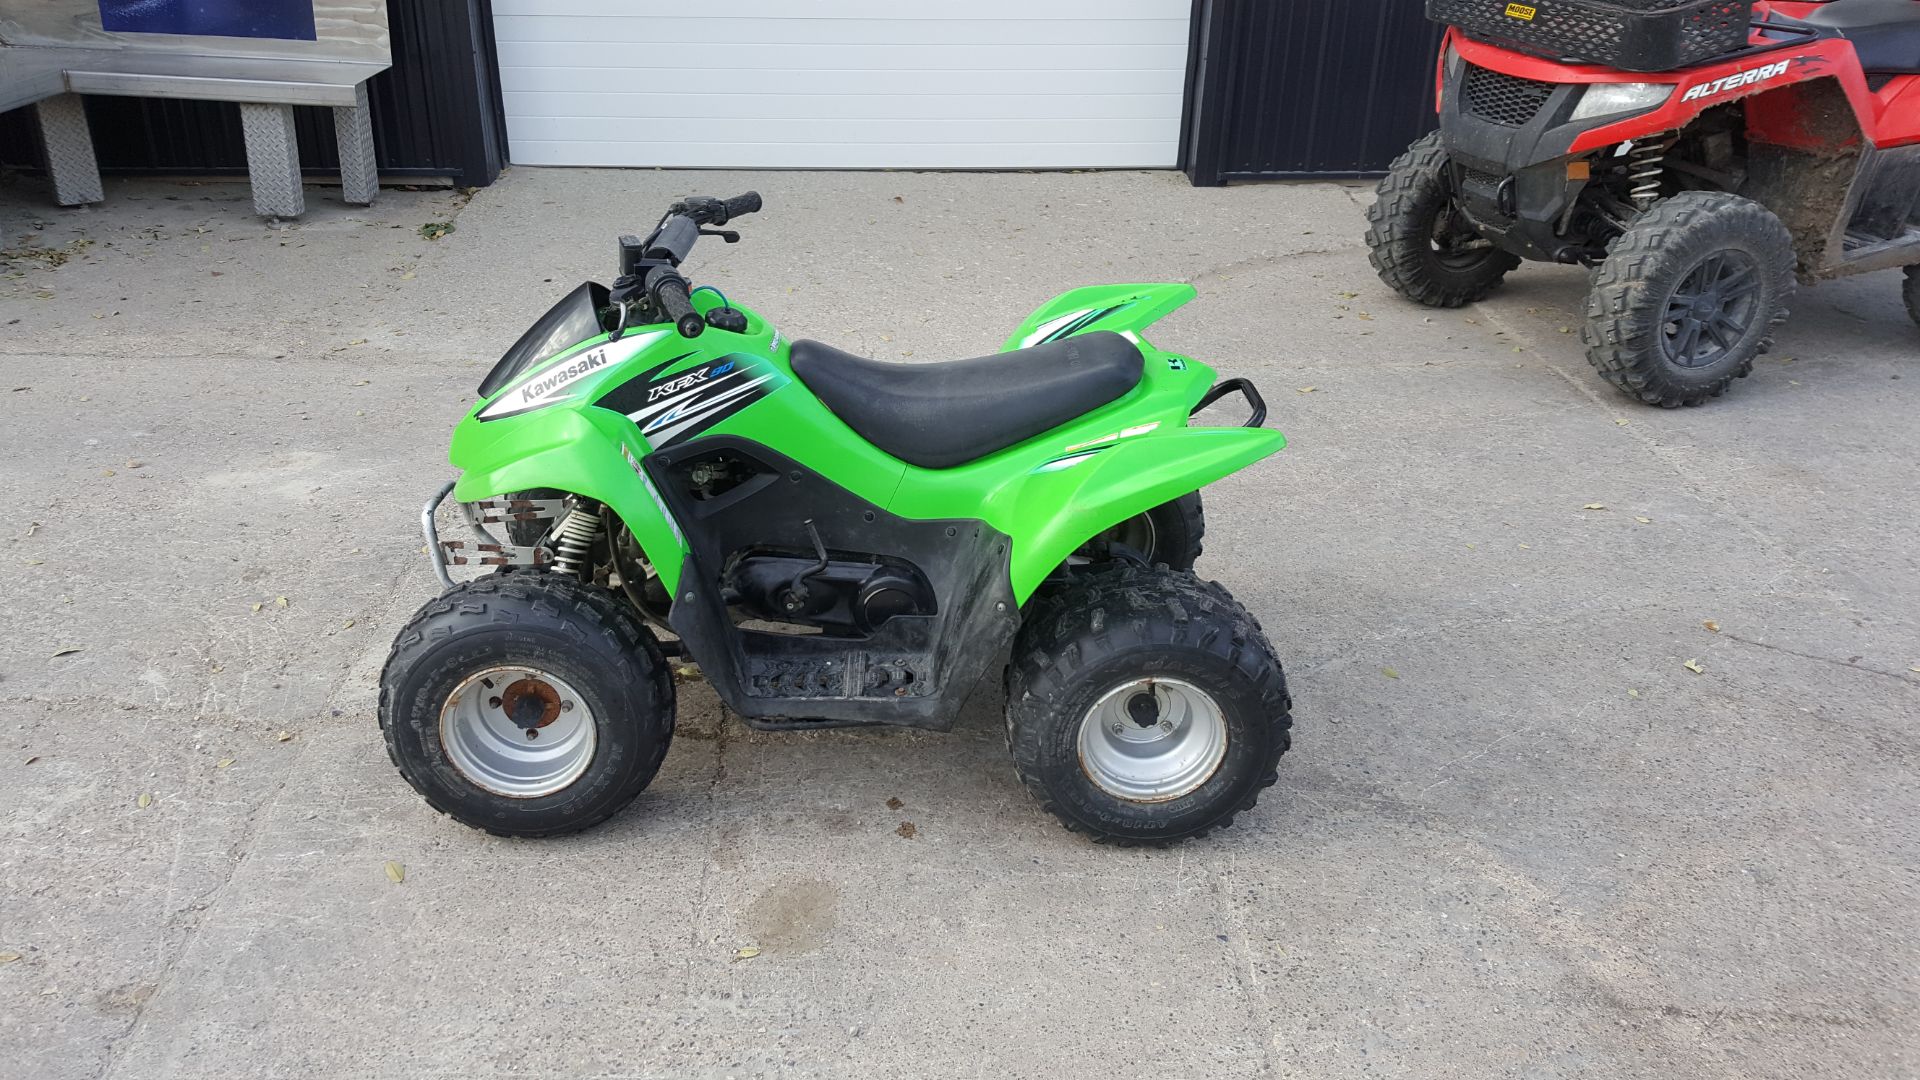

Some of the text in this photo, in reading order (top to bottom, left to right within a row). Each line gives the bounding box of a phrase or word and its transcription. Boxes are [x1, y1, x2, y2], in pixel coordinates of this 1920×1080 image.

[1508, 4, 1535, 16] MOOSE
[1680, 59, 1791, 103] ALTERRA
[521, 349, 608, 403] Kawasaki
[647, 360, 735, 402] KFX 90
